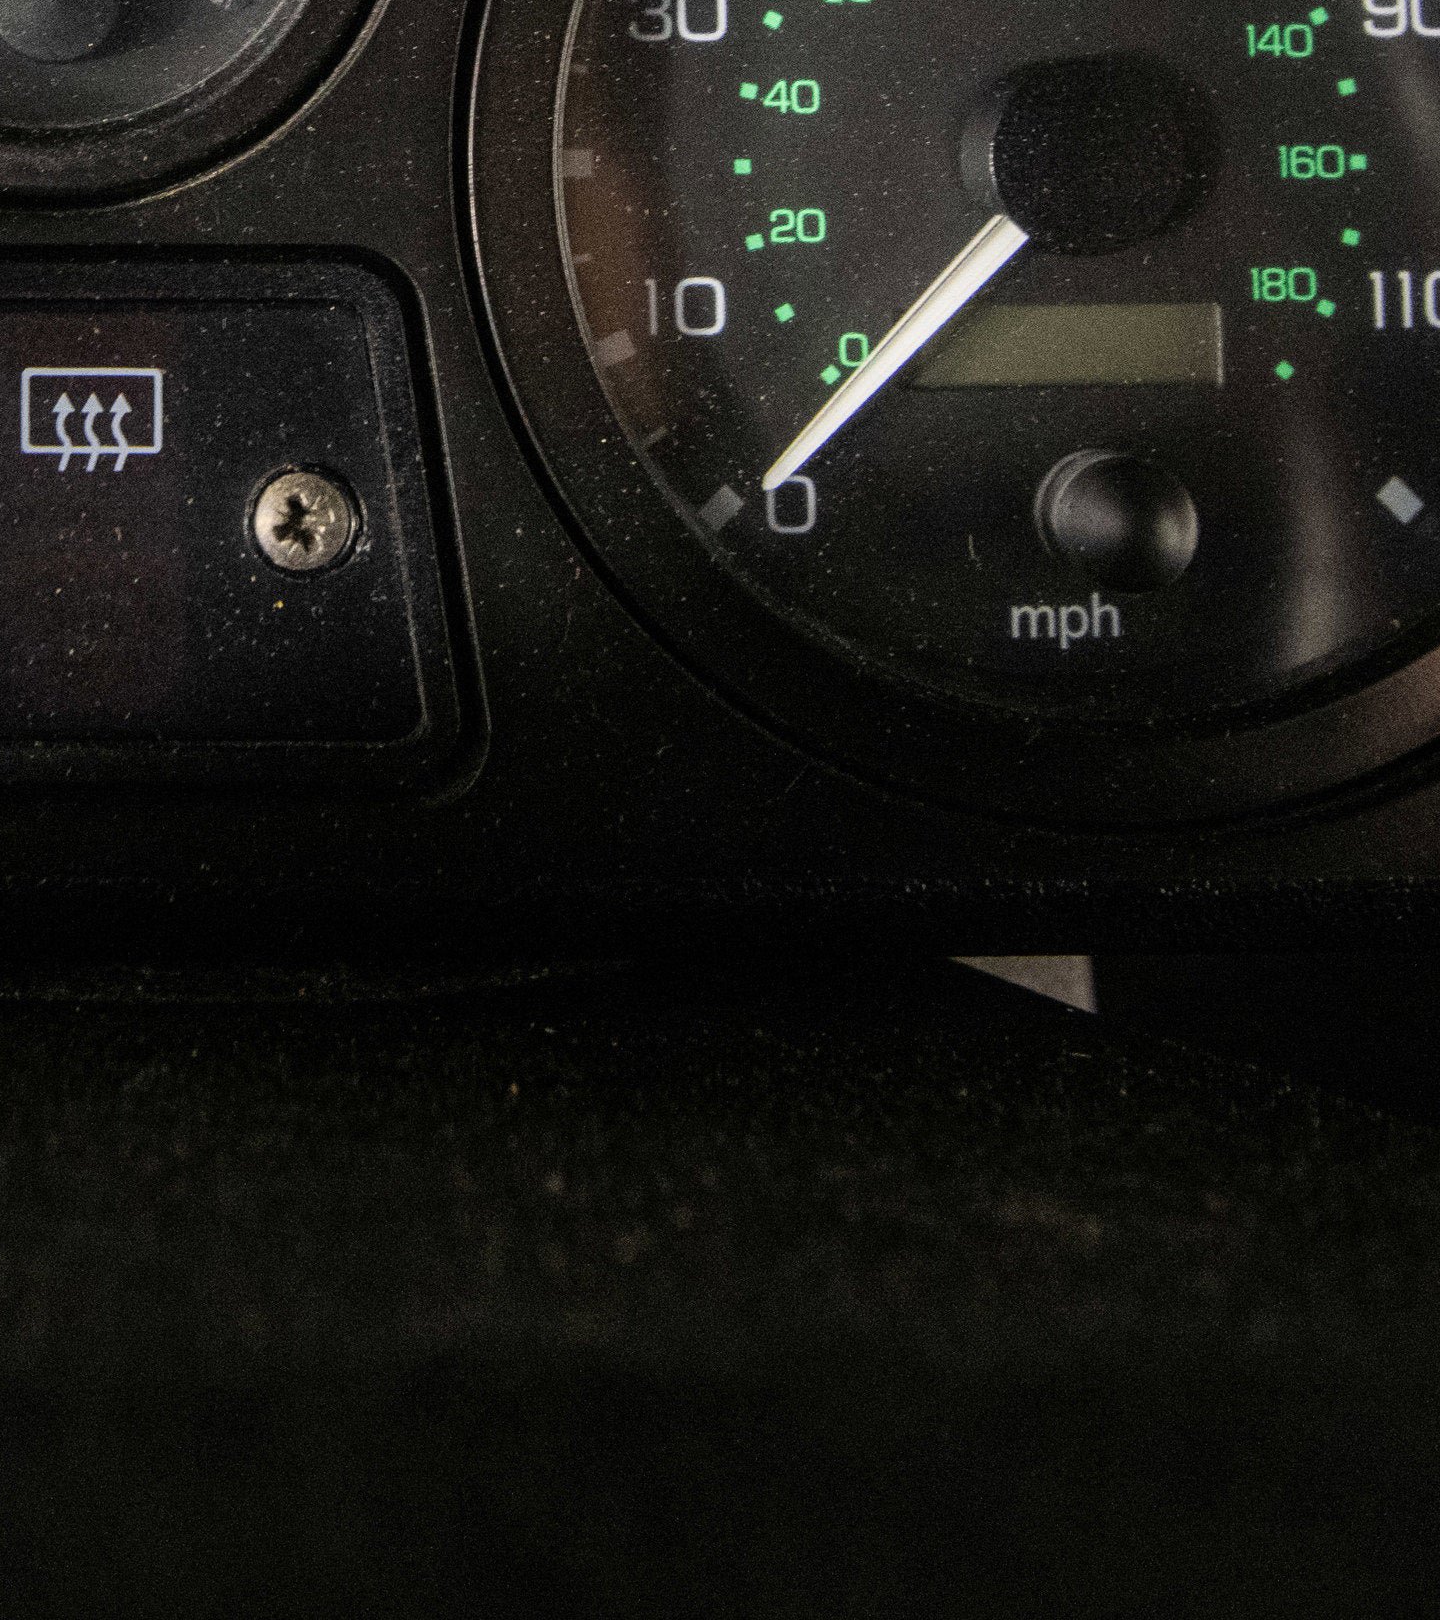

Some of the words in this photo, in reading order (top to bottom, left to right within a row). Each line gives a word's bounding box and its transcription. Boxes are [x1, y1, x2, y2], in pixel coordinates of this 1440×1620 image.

[1247, 23, 1313, 59] 140
[761, 79, 822, 116] 40
[1278, 145, 1346, 181] 160
[768, 208, 826, 244] 20
[1251, 266, 1317, 303] 180
[644, 276, 726, 336] 10
[839, 332, 869, 368] 0
[765, 474, 817, 534] 0
[1009, 593, 1121, 646] mph
